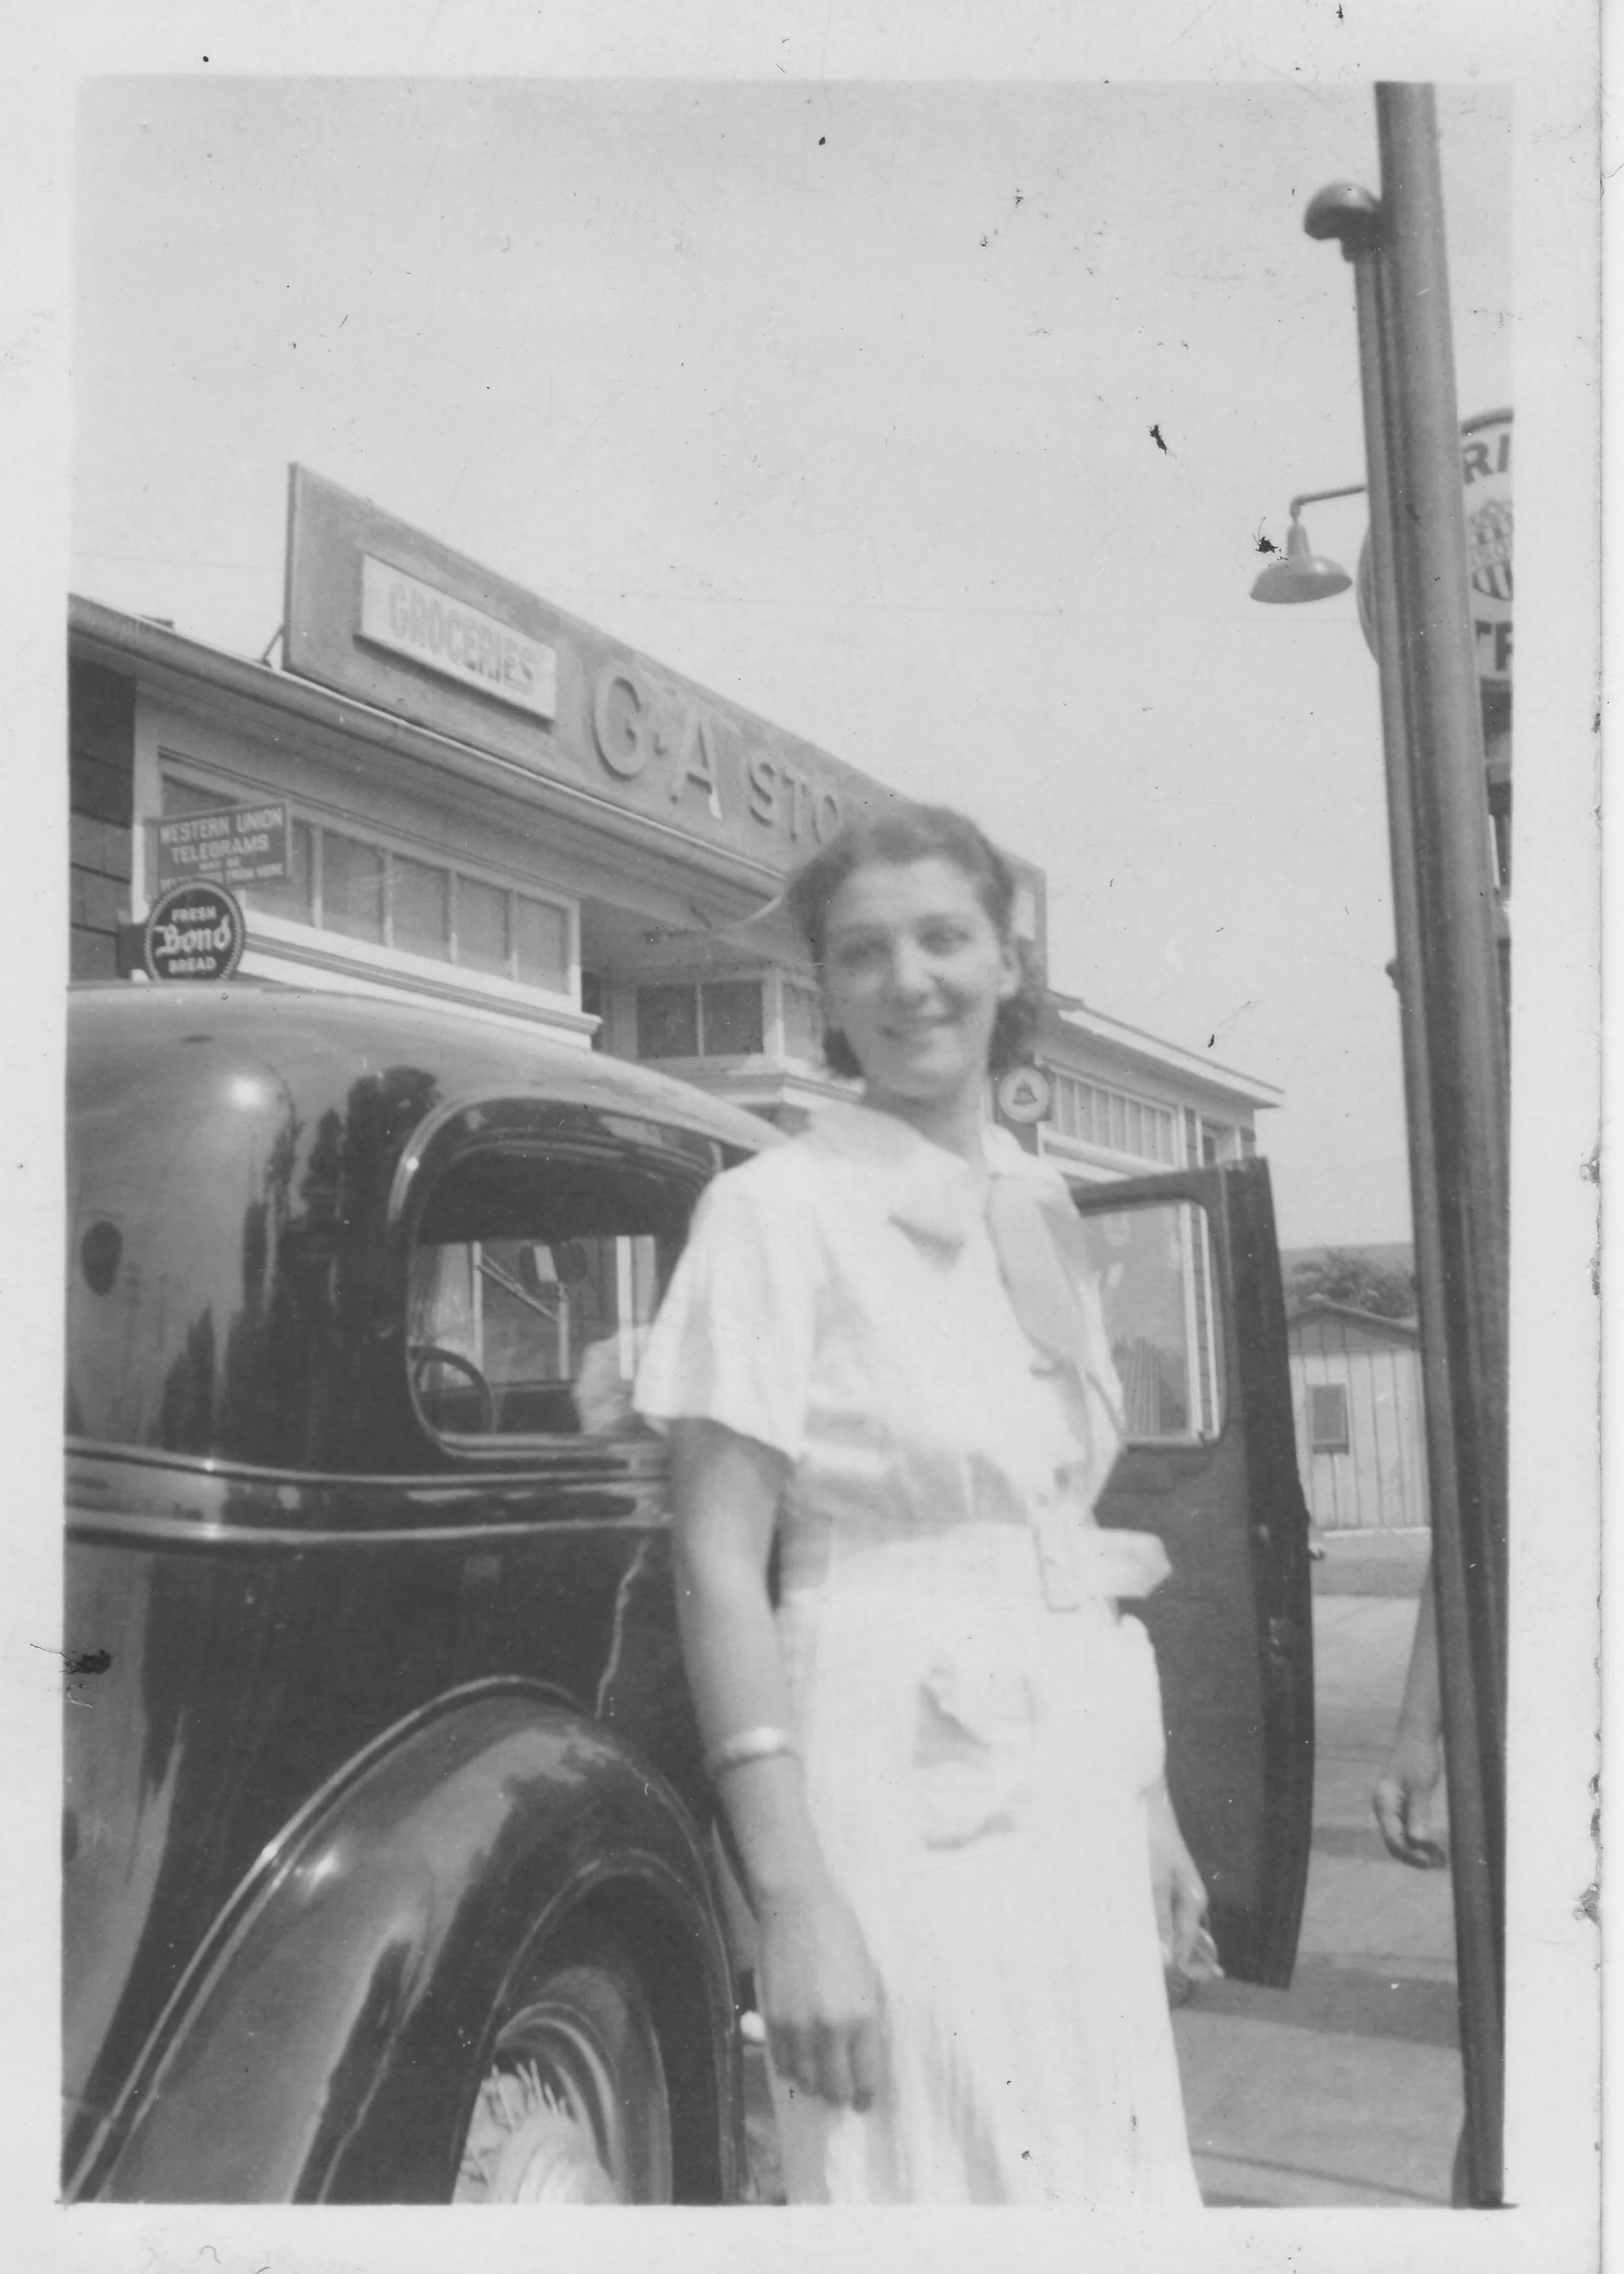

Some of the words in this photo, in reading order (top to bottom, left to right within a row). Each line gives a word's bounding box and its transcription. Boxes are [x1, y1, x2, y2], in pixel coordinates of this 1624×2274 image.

[388, 582, 535, 695] GROCERIES
[159, 815, 229, 845] WESTERN
[235, 807, 283, 834] UNION
[170, 834, 270, 865] TELEGRAMS
[171, 906, 216, 922] FRESH
[153, 913, 232, 958] Bond
[168, 956, 217, 973] BREAD
